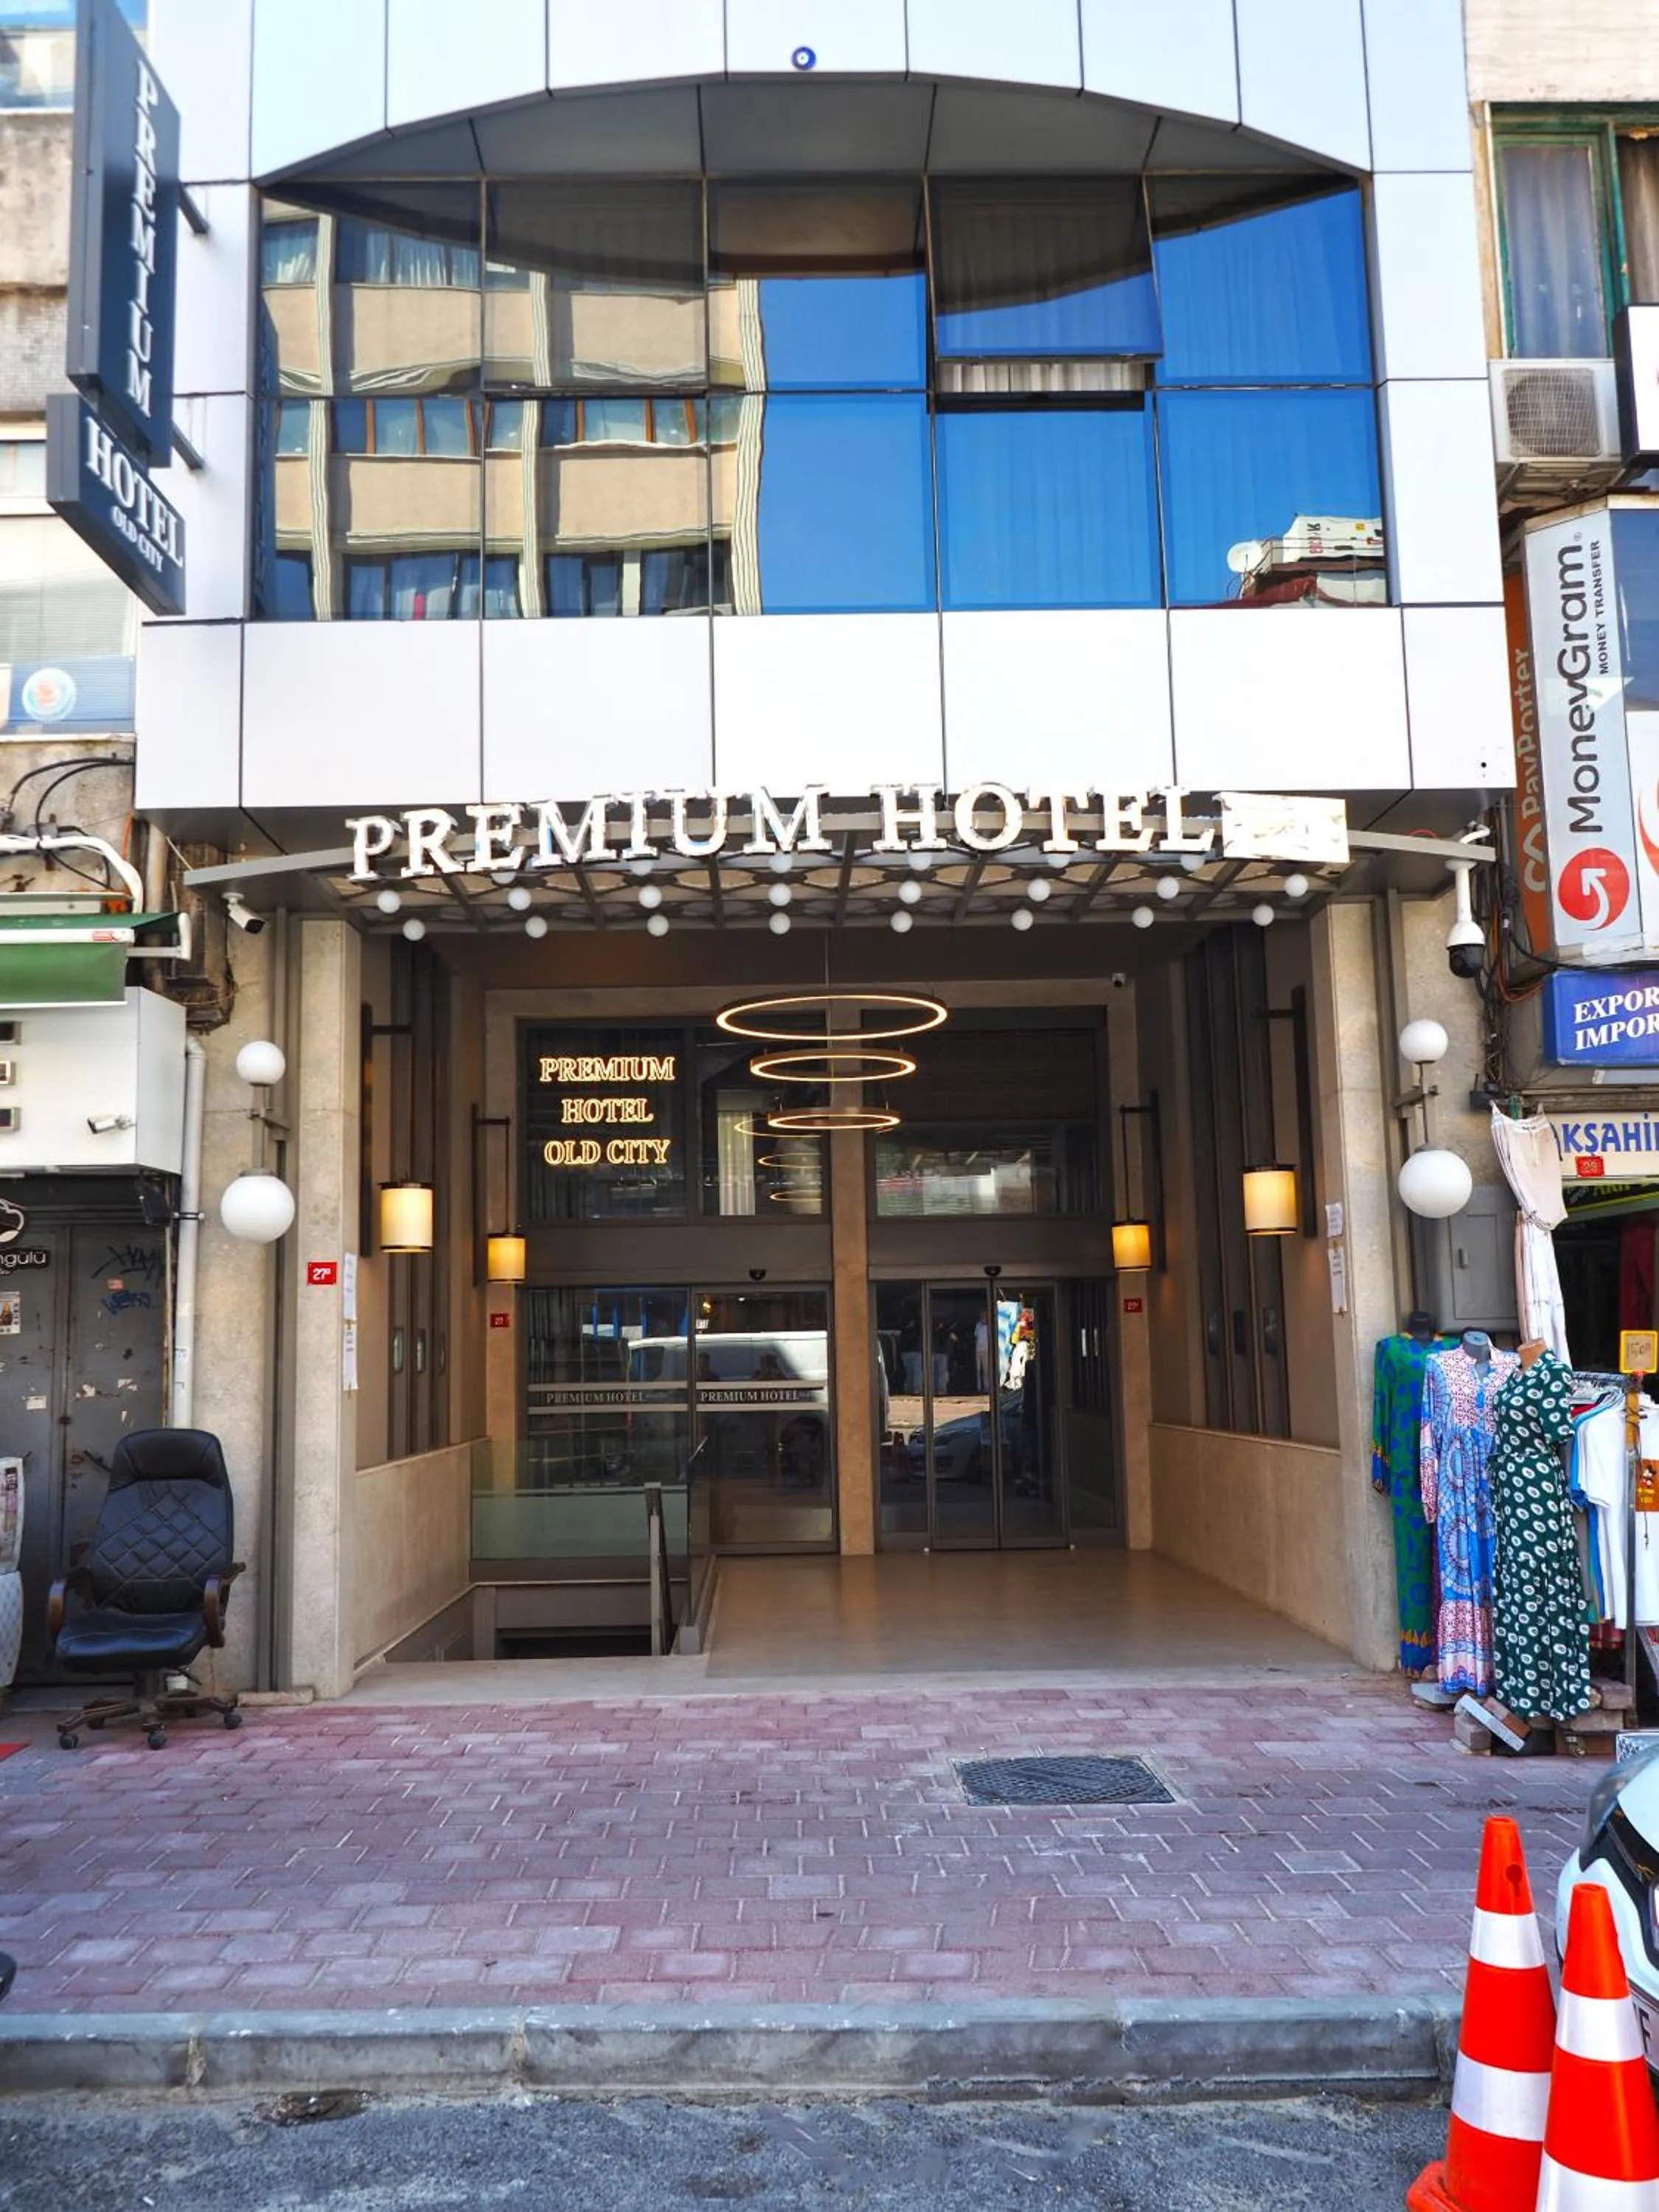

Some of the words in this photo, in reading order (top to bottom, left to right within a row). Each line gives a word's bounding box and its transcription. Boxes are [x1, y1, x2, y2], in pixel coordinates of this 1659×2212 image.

[126, 58, 158, 418] PREMIUM
[86, 416, 184, 568] HOTEL
[112, 506, 138, 544] OLD
[138, 532, 164, 573] CITY
[1590, 540, 1605, 618] TRANSFER
[1594, 622, 1609, 675] MONEY
[1557, 544, 1604, 832] MoneyGram
[345, 783, 832, 882] PREMIUM
[872, 782, 1215, 852] HOTEL
[1573, 986, 1659, 1024] EXPOR
[1575, 1012, 1659, 1051] IMPOR
[539, 1057, 675, 1082] PREMIUM
[561, 1098, 654, 1124] HOTEL
[543, 1141, 601, 1165] OLD
[606, 1139, 672, 1165] CITY
[546, 1392, 604, 1404] PREMIUM
[607, 1391, 644, 1402] HOTEL
[700, 1391, 757, 1402] PREMIUM
[760, 1390, 799, 1401] HOTEL
